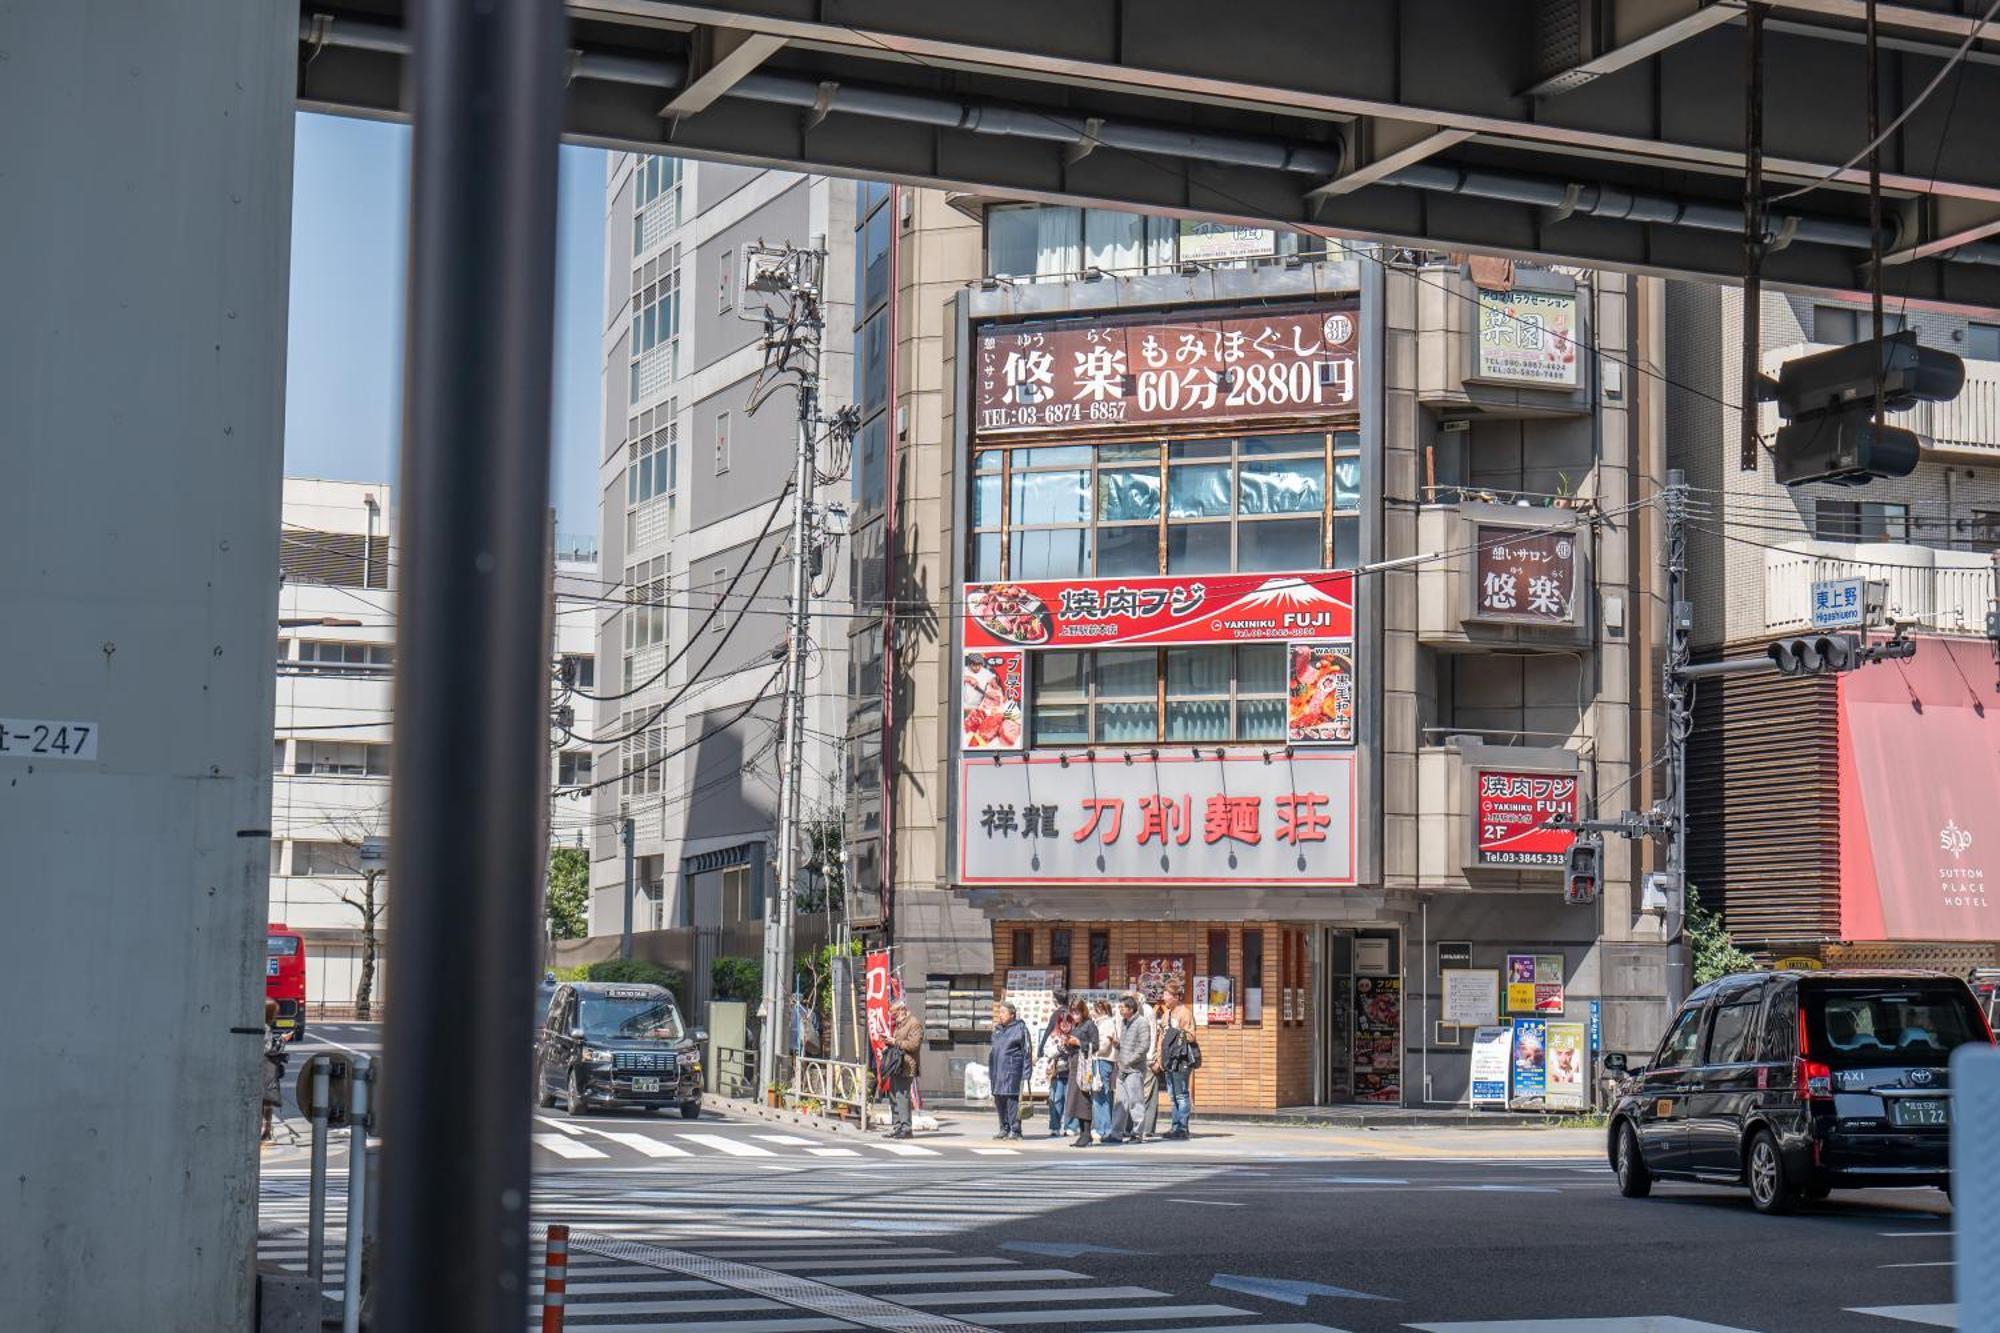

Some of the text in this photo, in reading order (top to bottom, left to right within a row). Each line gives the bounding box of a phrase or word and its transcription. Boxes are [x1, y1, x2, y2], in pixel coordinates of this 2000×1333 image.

[1017, 328, 1113, 347] ゆう らく
[1142, 325, 1321, 367] もみほぐし
[983, 401, 1127, 427] TEL:03-6874-6857
[1057, 582, 1207, 621] 焼肉フジ
[1816, 587, 1857, 610] 東上野
[1224, 612, 1331, 629] YAKINIKU FUJI
[1481, 775, 1574, 799] 焼肉フジ
[1493, 801, 1572, 813] YAKINIKU FUJI
[1484, 825, 1508, 839] 2F
[1485, 852, 1568, 864] Tel.03-3845-233
[1939, 868, 1984, 878] SUTTON
[1942, 883, 1985, 893] PLACE
[1944, 896, 1988, 907] HOTEL
[1834, 1072, 1864, 1081] TAXI
